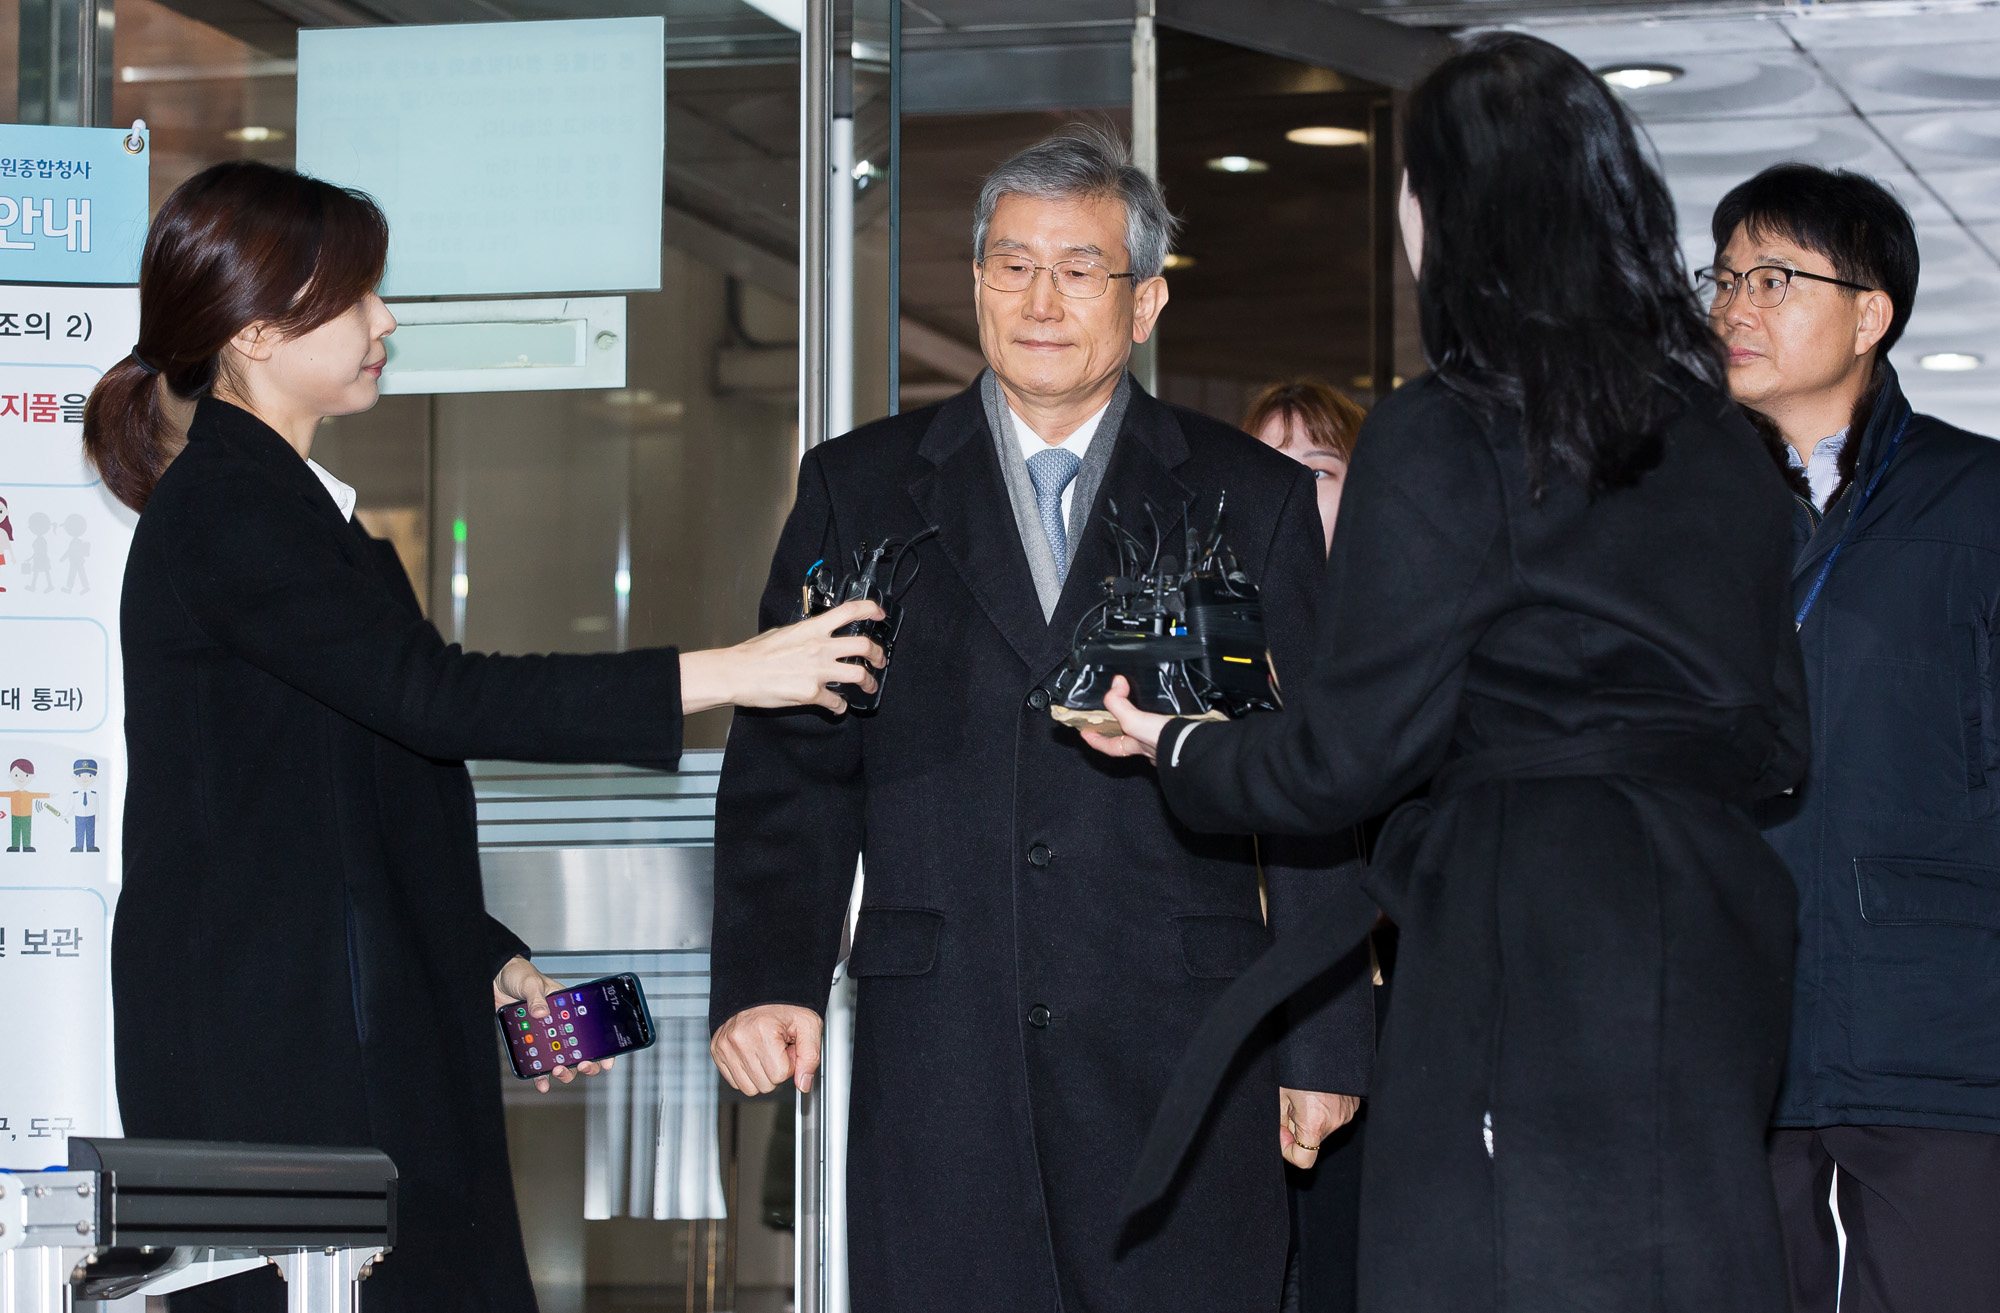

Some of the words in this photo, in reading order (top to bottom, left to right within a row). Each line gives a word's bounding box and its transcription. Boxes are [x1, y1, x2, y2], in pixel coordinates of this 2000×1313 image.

[0, 158, 92, 180] 원종합청사
[0, 195, 92, 253] 안내
[0, 312, 51, 340] 조의
[66, 312, 93, 342] 2)
[0, 392, 86, 423] 지품을
[1, 687, 20, 711] 대
[31, 687, 83, 712] 통과)
[20, 927, 83, 957] 보관
[28, 1117, 76, 1140] 도구
